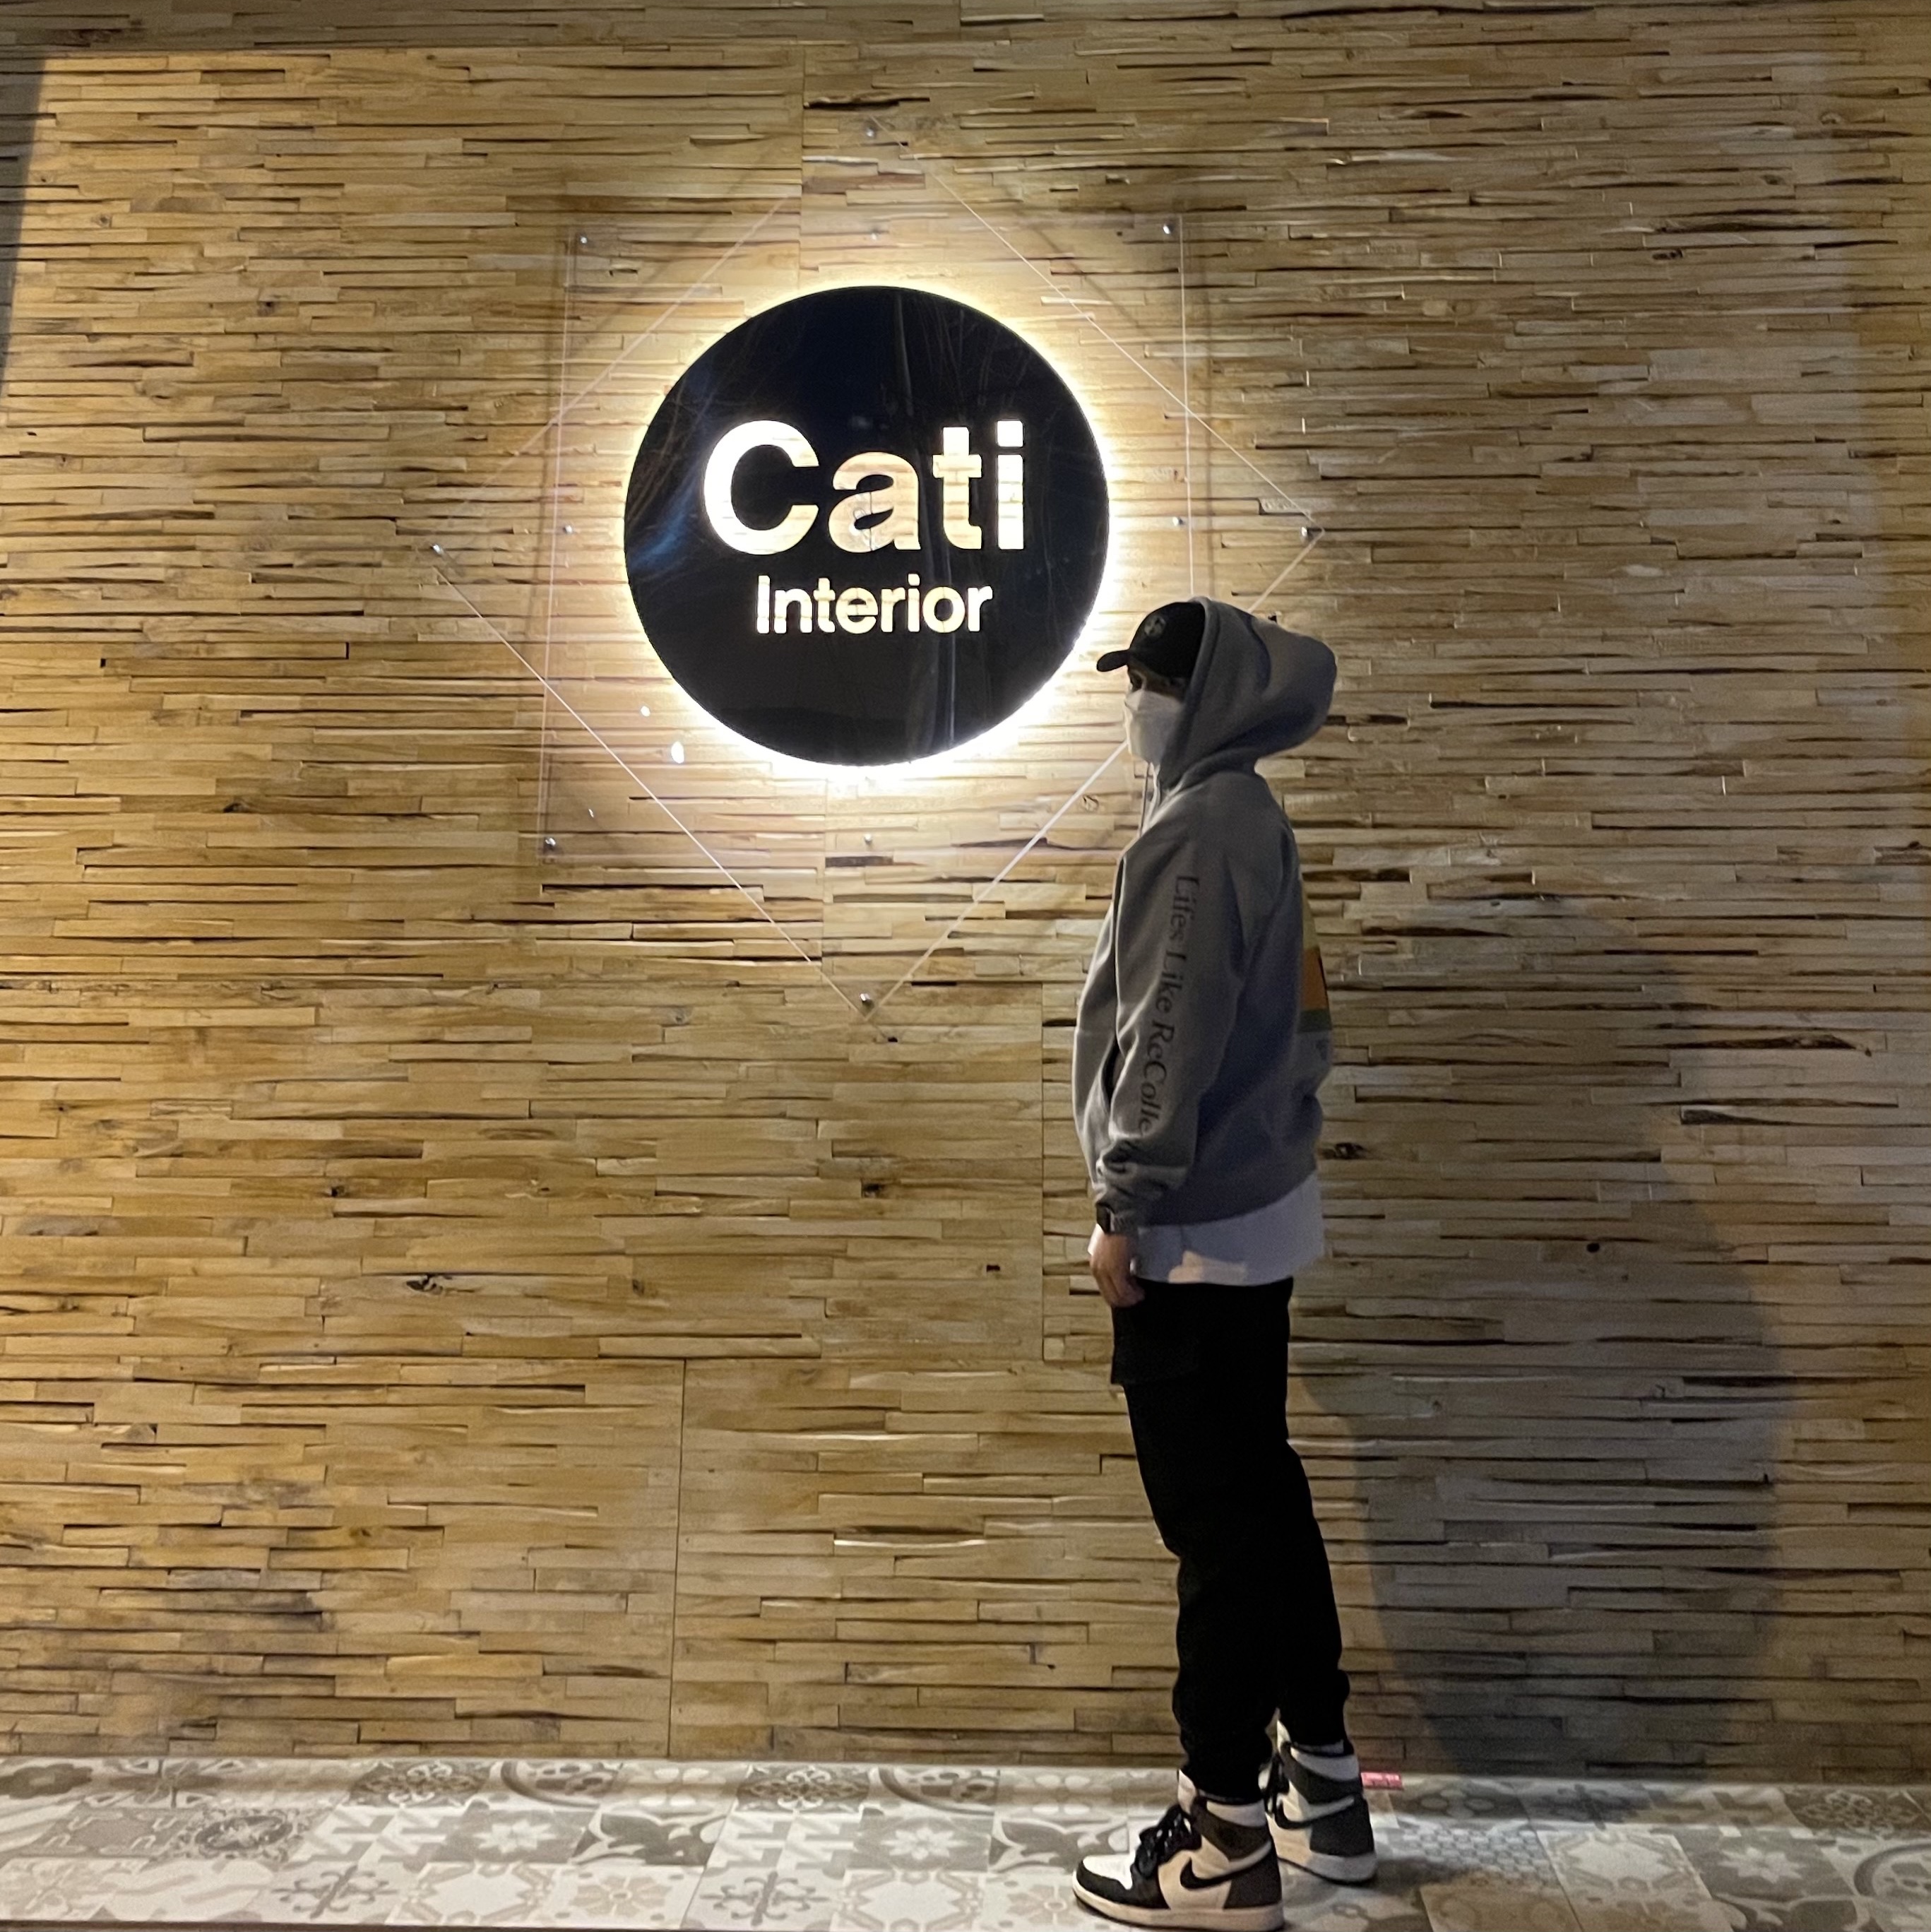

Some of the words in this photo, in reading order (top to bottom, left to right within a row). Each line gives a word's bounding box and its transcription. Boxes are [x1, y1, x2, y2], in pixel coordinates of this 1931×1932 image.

[702, 420, 1024, 555] Cati
[755, 574, 993, 634] Interior
[1155, 948, 1187, 1013] Like
